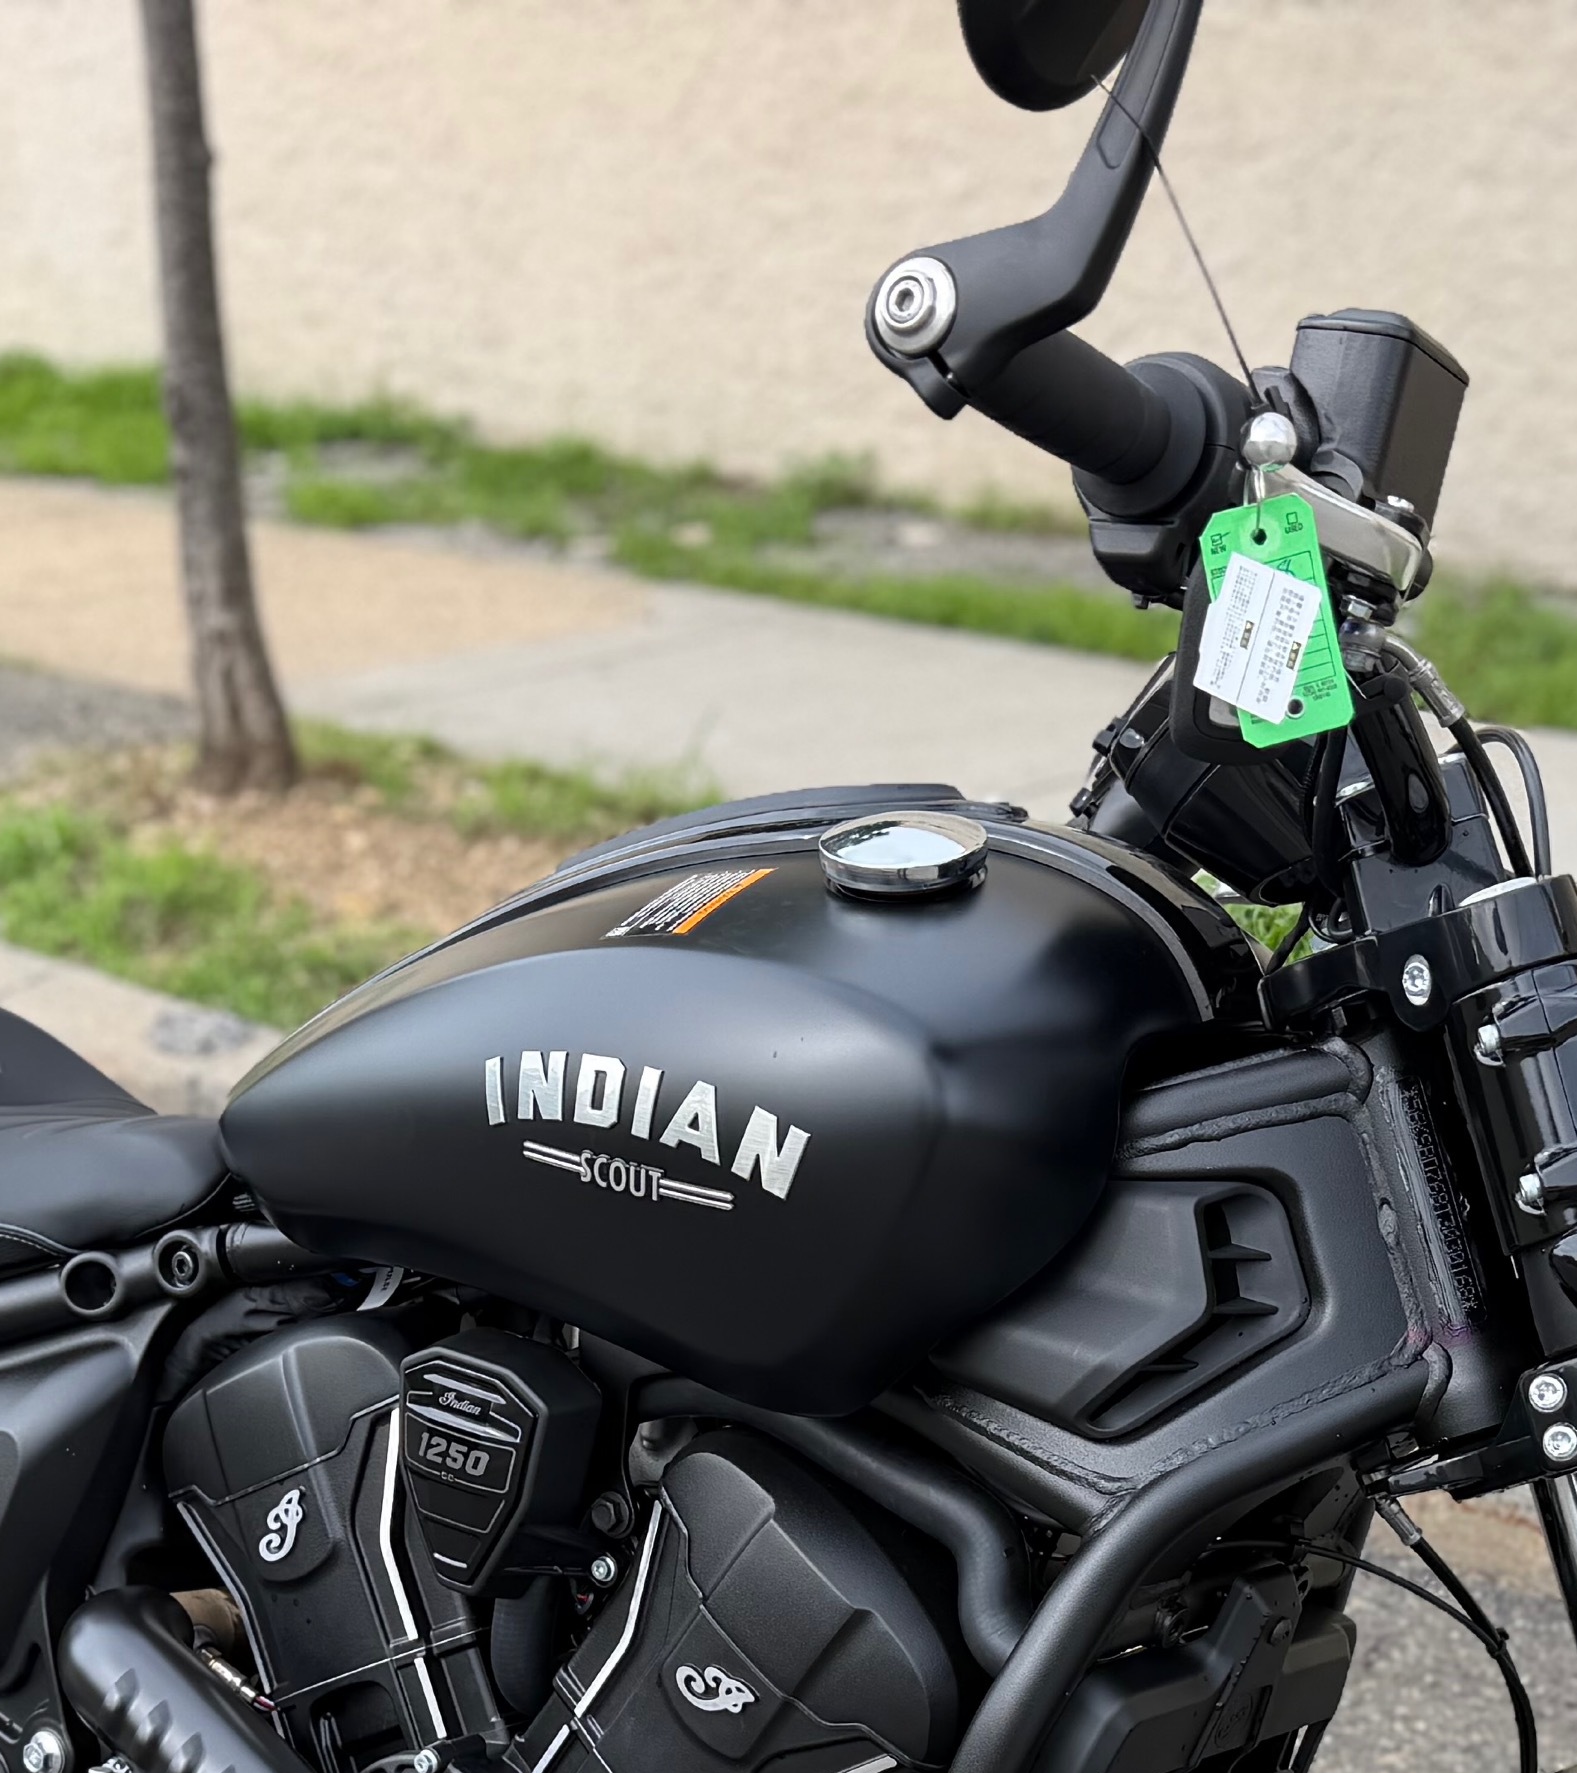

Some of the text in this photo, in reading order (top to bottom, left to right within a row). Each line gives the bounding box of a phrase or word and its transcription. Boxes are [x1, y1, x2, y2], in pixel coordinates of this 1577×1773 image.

[485, 1050, 811, 1200] INDIAN
[579, 1149, 665, 1201] SCOUT
[438, 1391, 482, 1416] Indian
[418, 1431, 490, 1477] 1250
